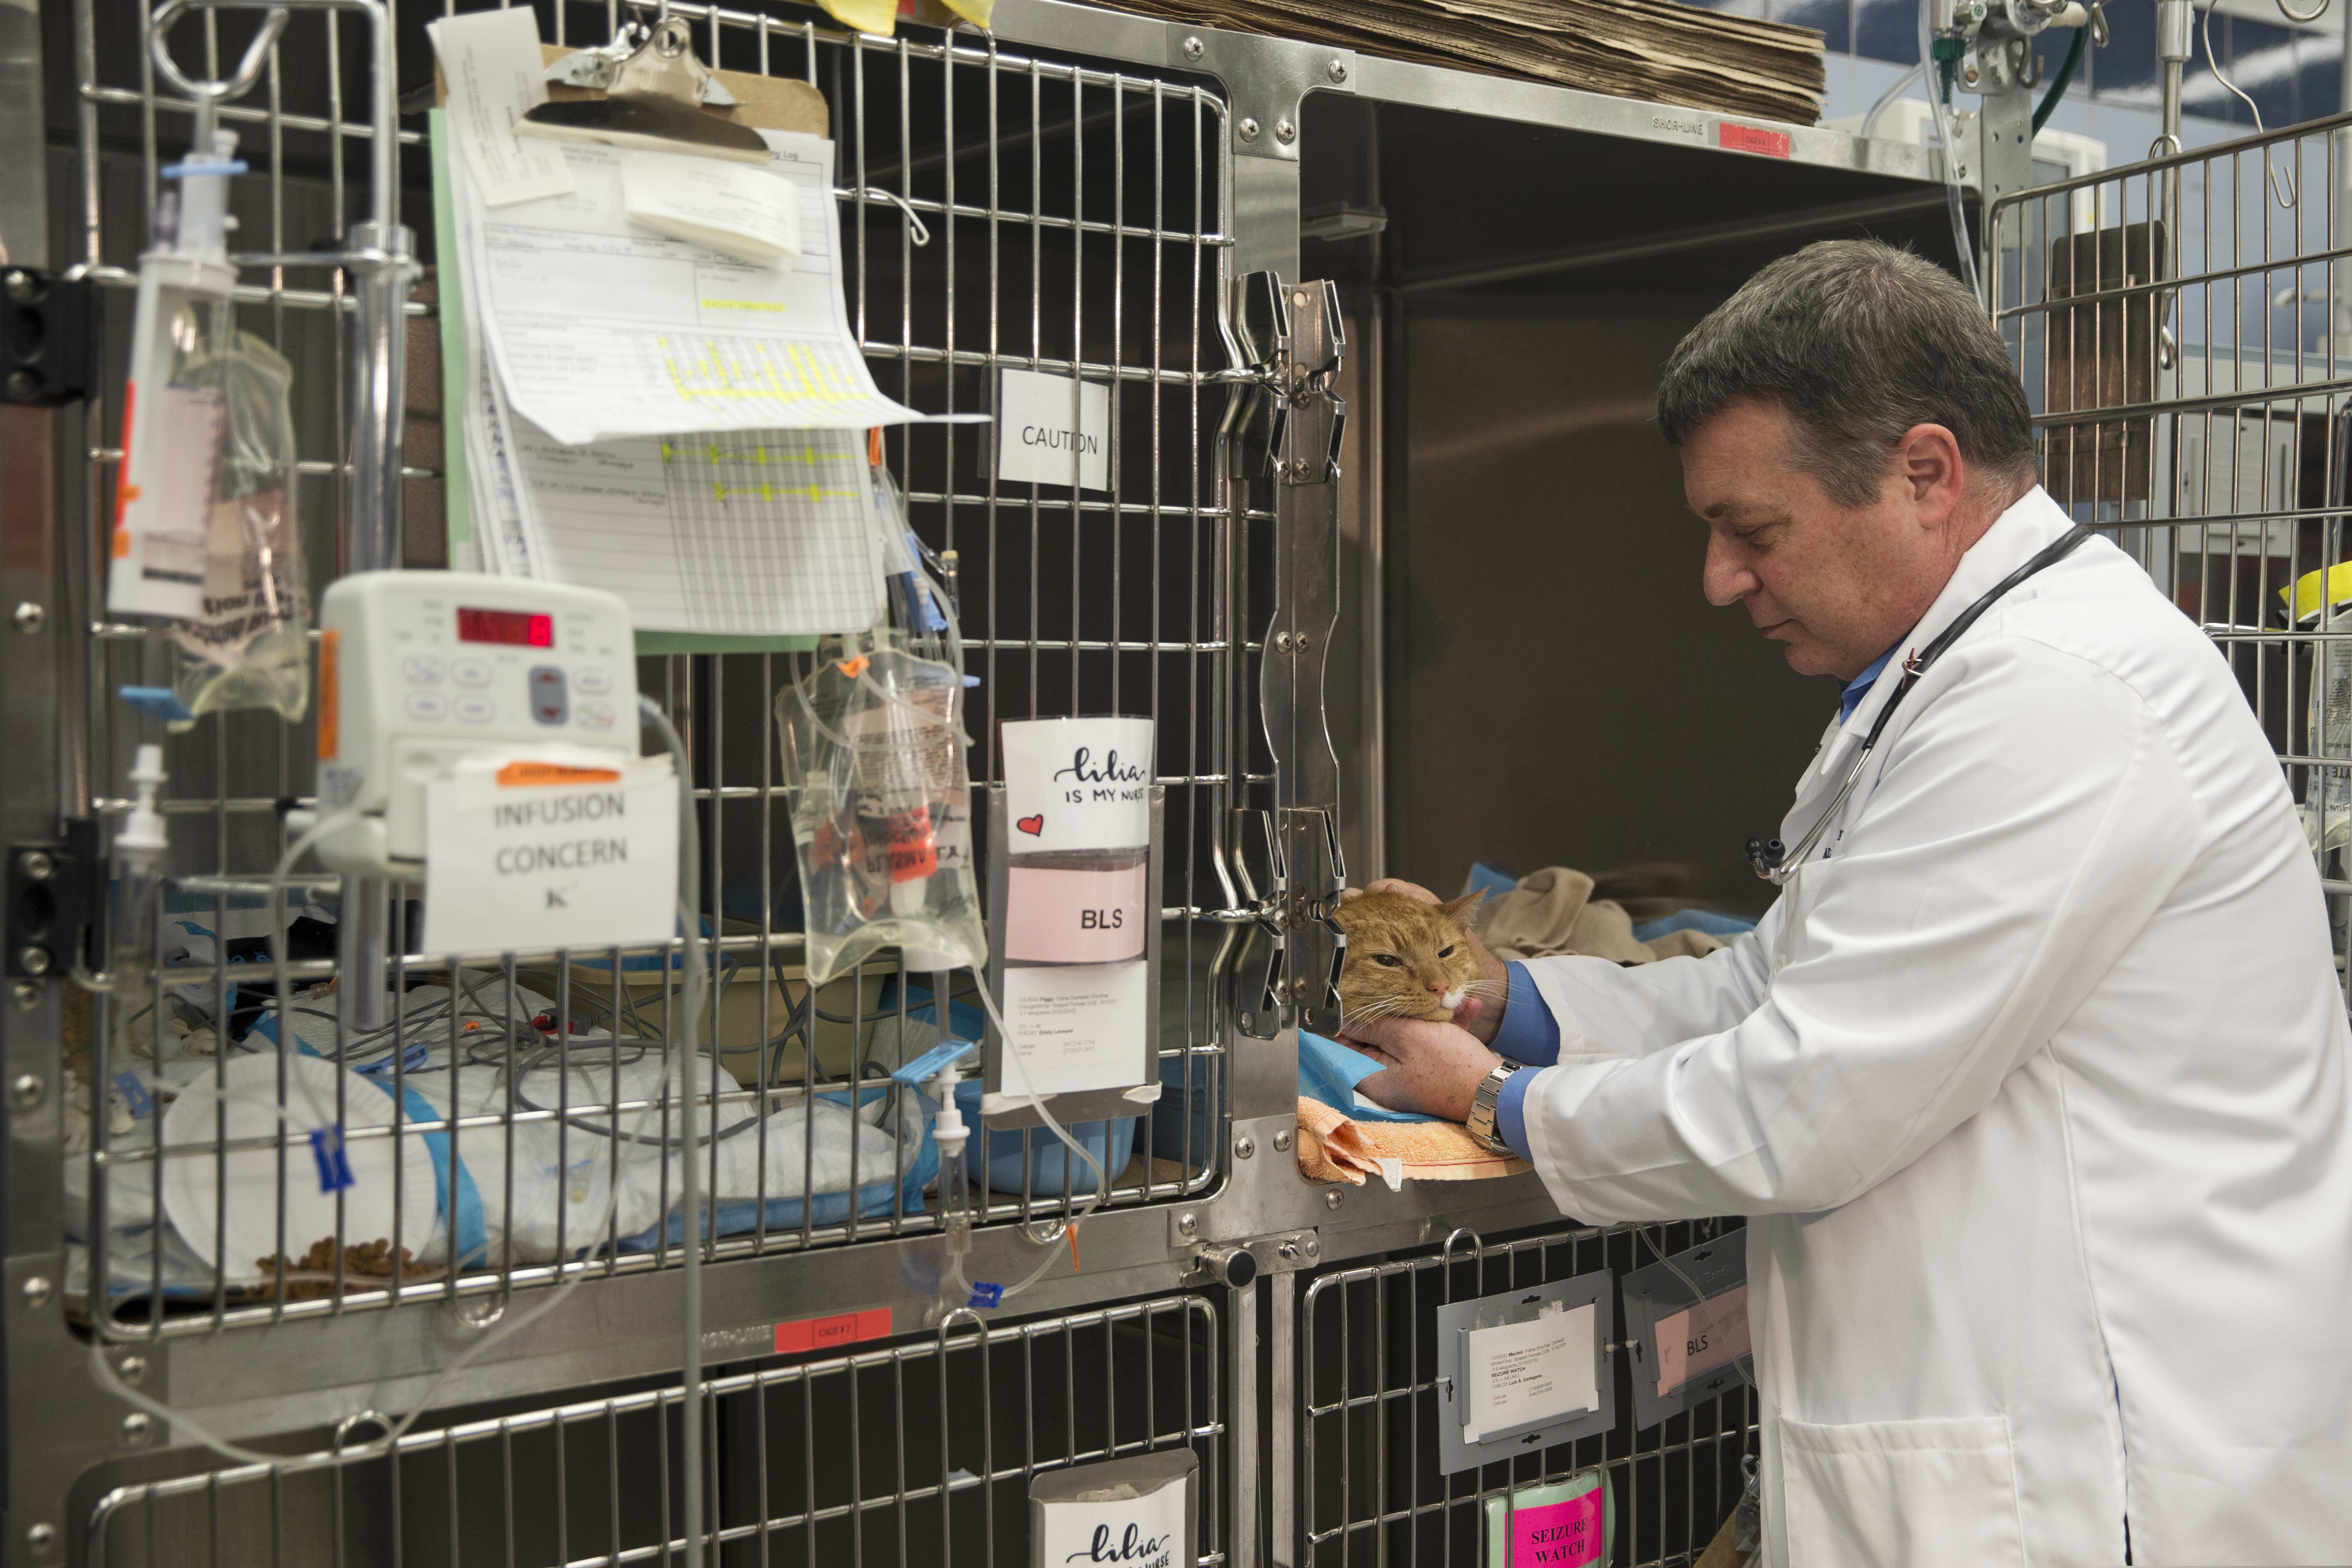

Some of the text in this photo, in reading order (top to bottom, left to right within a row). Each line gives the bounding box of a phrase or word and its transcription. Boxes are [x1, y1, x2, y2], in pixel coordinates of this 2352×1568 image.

[783, 151, 798, 161] Log
[1055, 747, 1145, 782] lilia
[1066, 788, 1143, 803] IS MY NURSE
[495, 793, 624, 826] INFUSION
[496, 838, 627, 874] CONCERN
[1082, 909, 1122, 929] BLS
[1687, 1335, 1708, 1356] BLS
[1066, 1523, 1170, 1563] lilia
[1531, 1518, 1587, 1545] SEIZURE
[1535, 1539, 1585, 1564] WATCH
